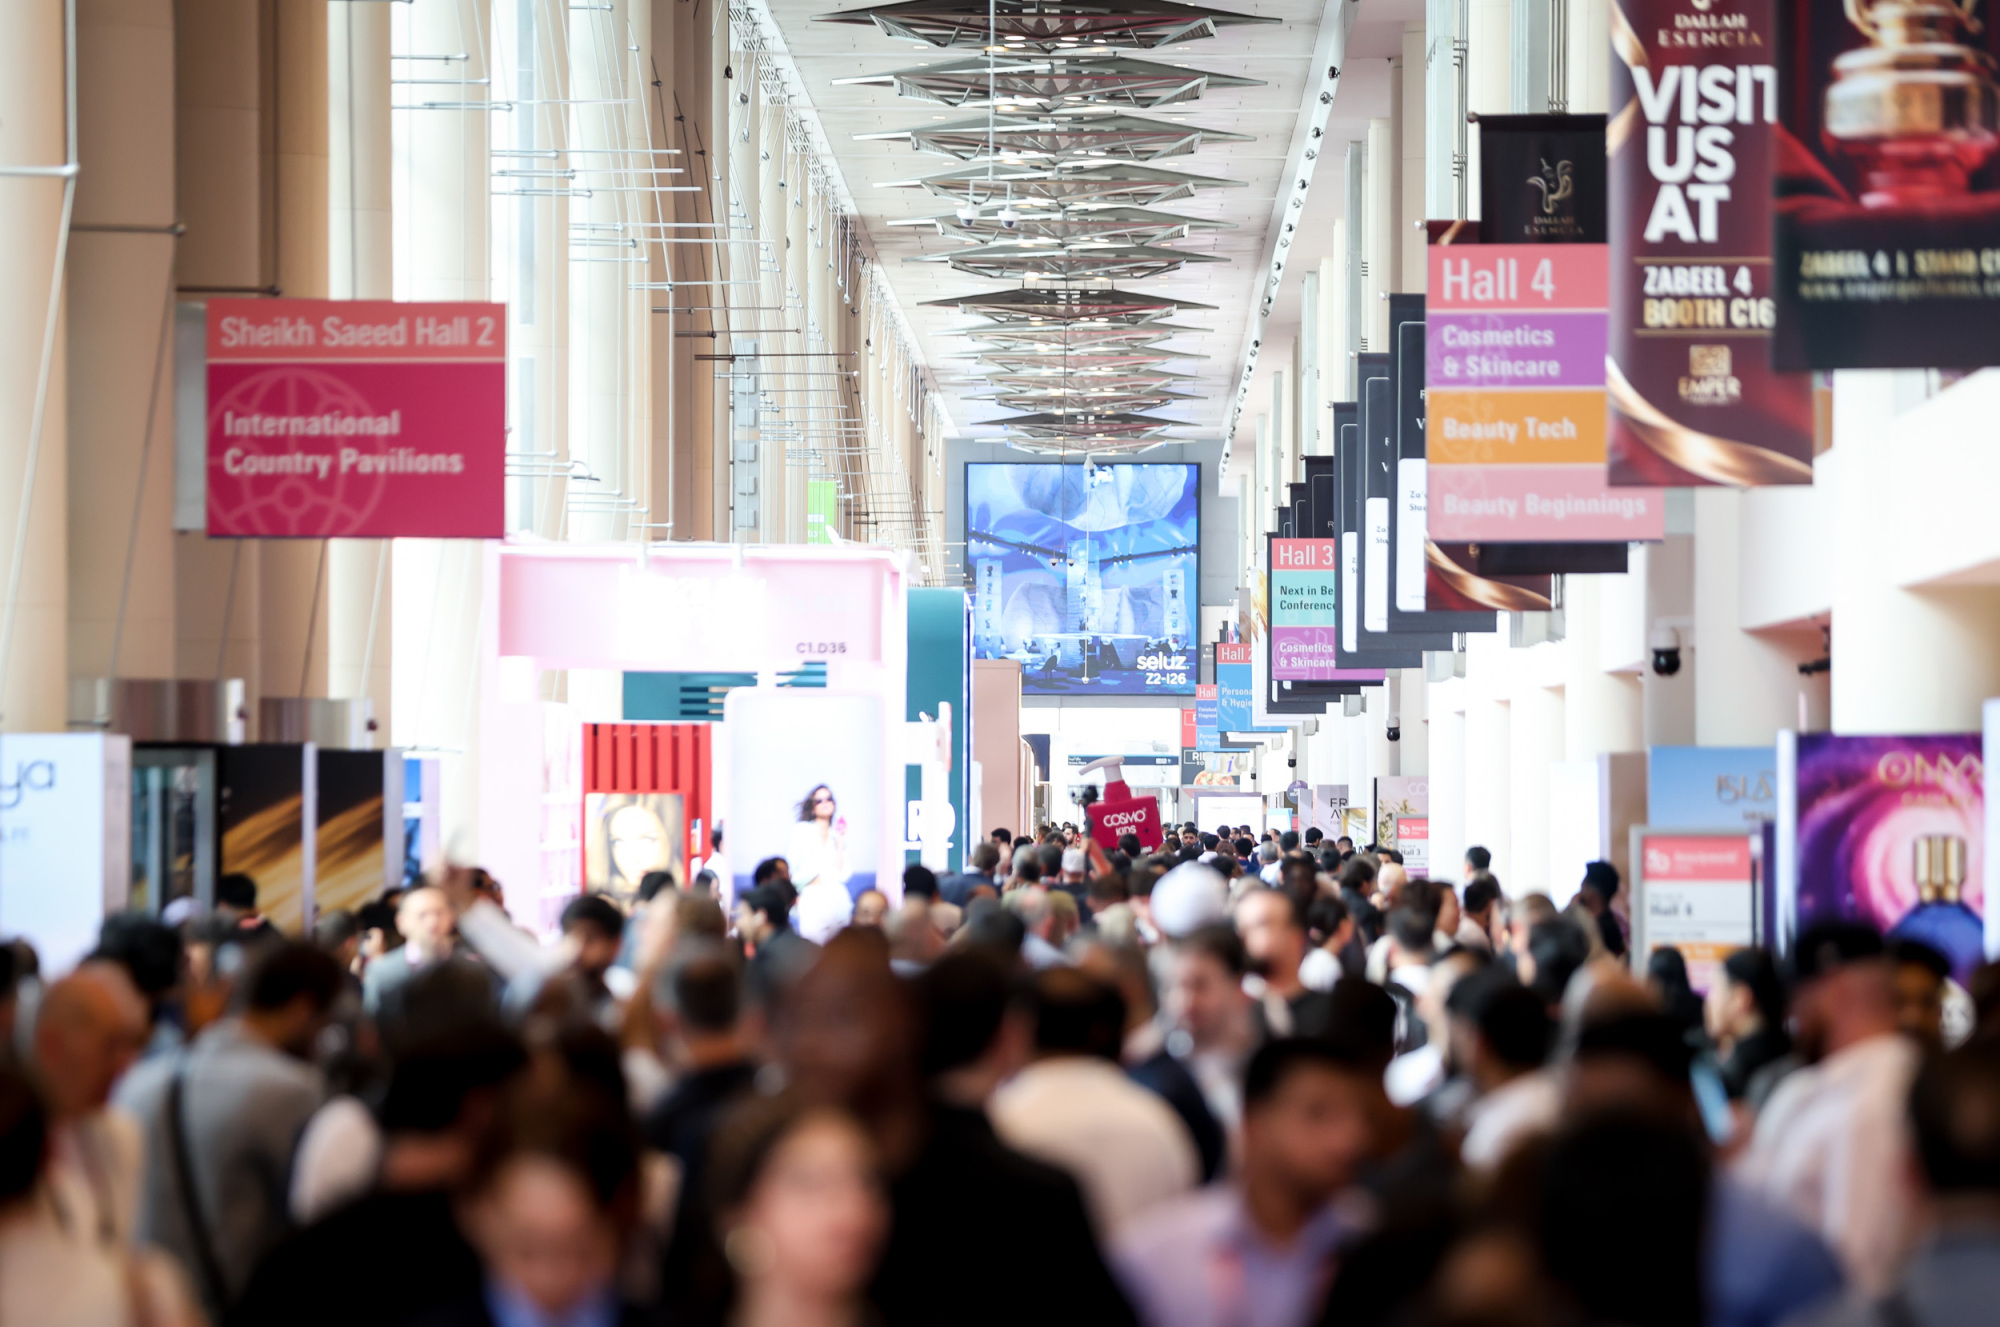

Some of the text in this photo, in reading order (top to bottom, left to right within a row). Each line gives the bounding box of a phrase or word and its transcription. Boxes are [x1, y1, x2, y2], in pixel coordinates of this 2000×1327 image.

[1674, 13, 1748, 30] DALLAH
[1657, 29, 1763, 48] ESENCIA
[1631, 64, 1778, 125] VISIT
[1647, 125, 1736, 183] US
[1643, 183, 1731, 242] AT
[1442, 257, 1556, 301] Hall 4
[1643, 265, 1753, 296] ZABEEL 4
[1643, 297, 1777, 329] BOOTH C16
[219, 316, 495, 348] Sheikh Saeed Hall 2
[1442, 324, 1556, 347] Cosmetics
[1442, 354, 1561, 378] & Skincare
[224, 410, 401, 437] International
[1443, 417, 1519, 445] Beauty
[1524, 416, 1578, 440] Tech
[224, 446, 465, 480] Country Pavilions
[1443, 493, 1647, 521] Beauty Beginnings
[1279, 544, 1334, 566] Hall 3
[1279, 585, 1304, 596] Next
[1307, 585, 1317, 596] in
[1279, 600, 1335, 611] Conferenc
[1221, 647, 1245, 661] Hall
[1279, 642, 1333, 653] Cosmetics
[1279, 656, 1336, 669] & Skincare
[1198, 687, 1217, 698] Hall
[1103, 809, 1146, 827] COSMO
[1116, 825, 1137, 836] KIDS
